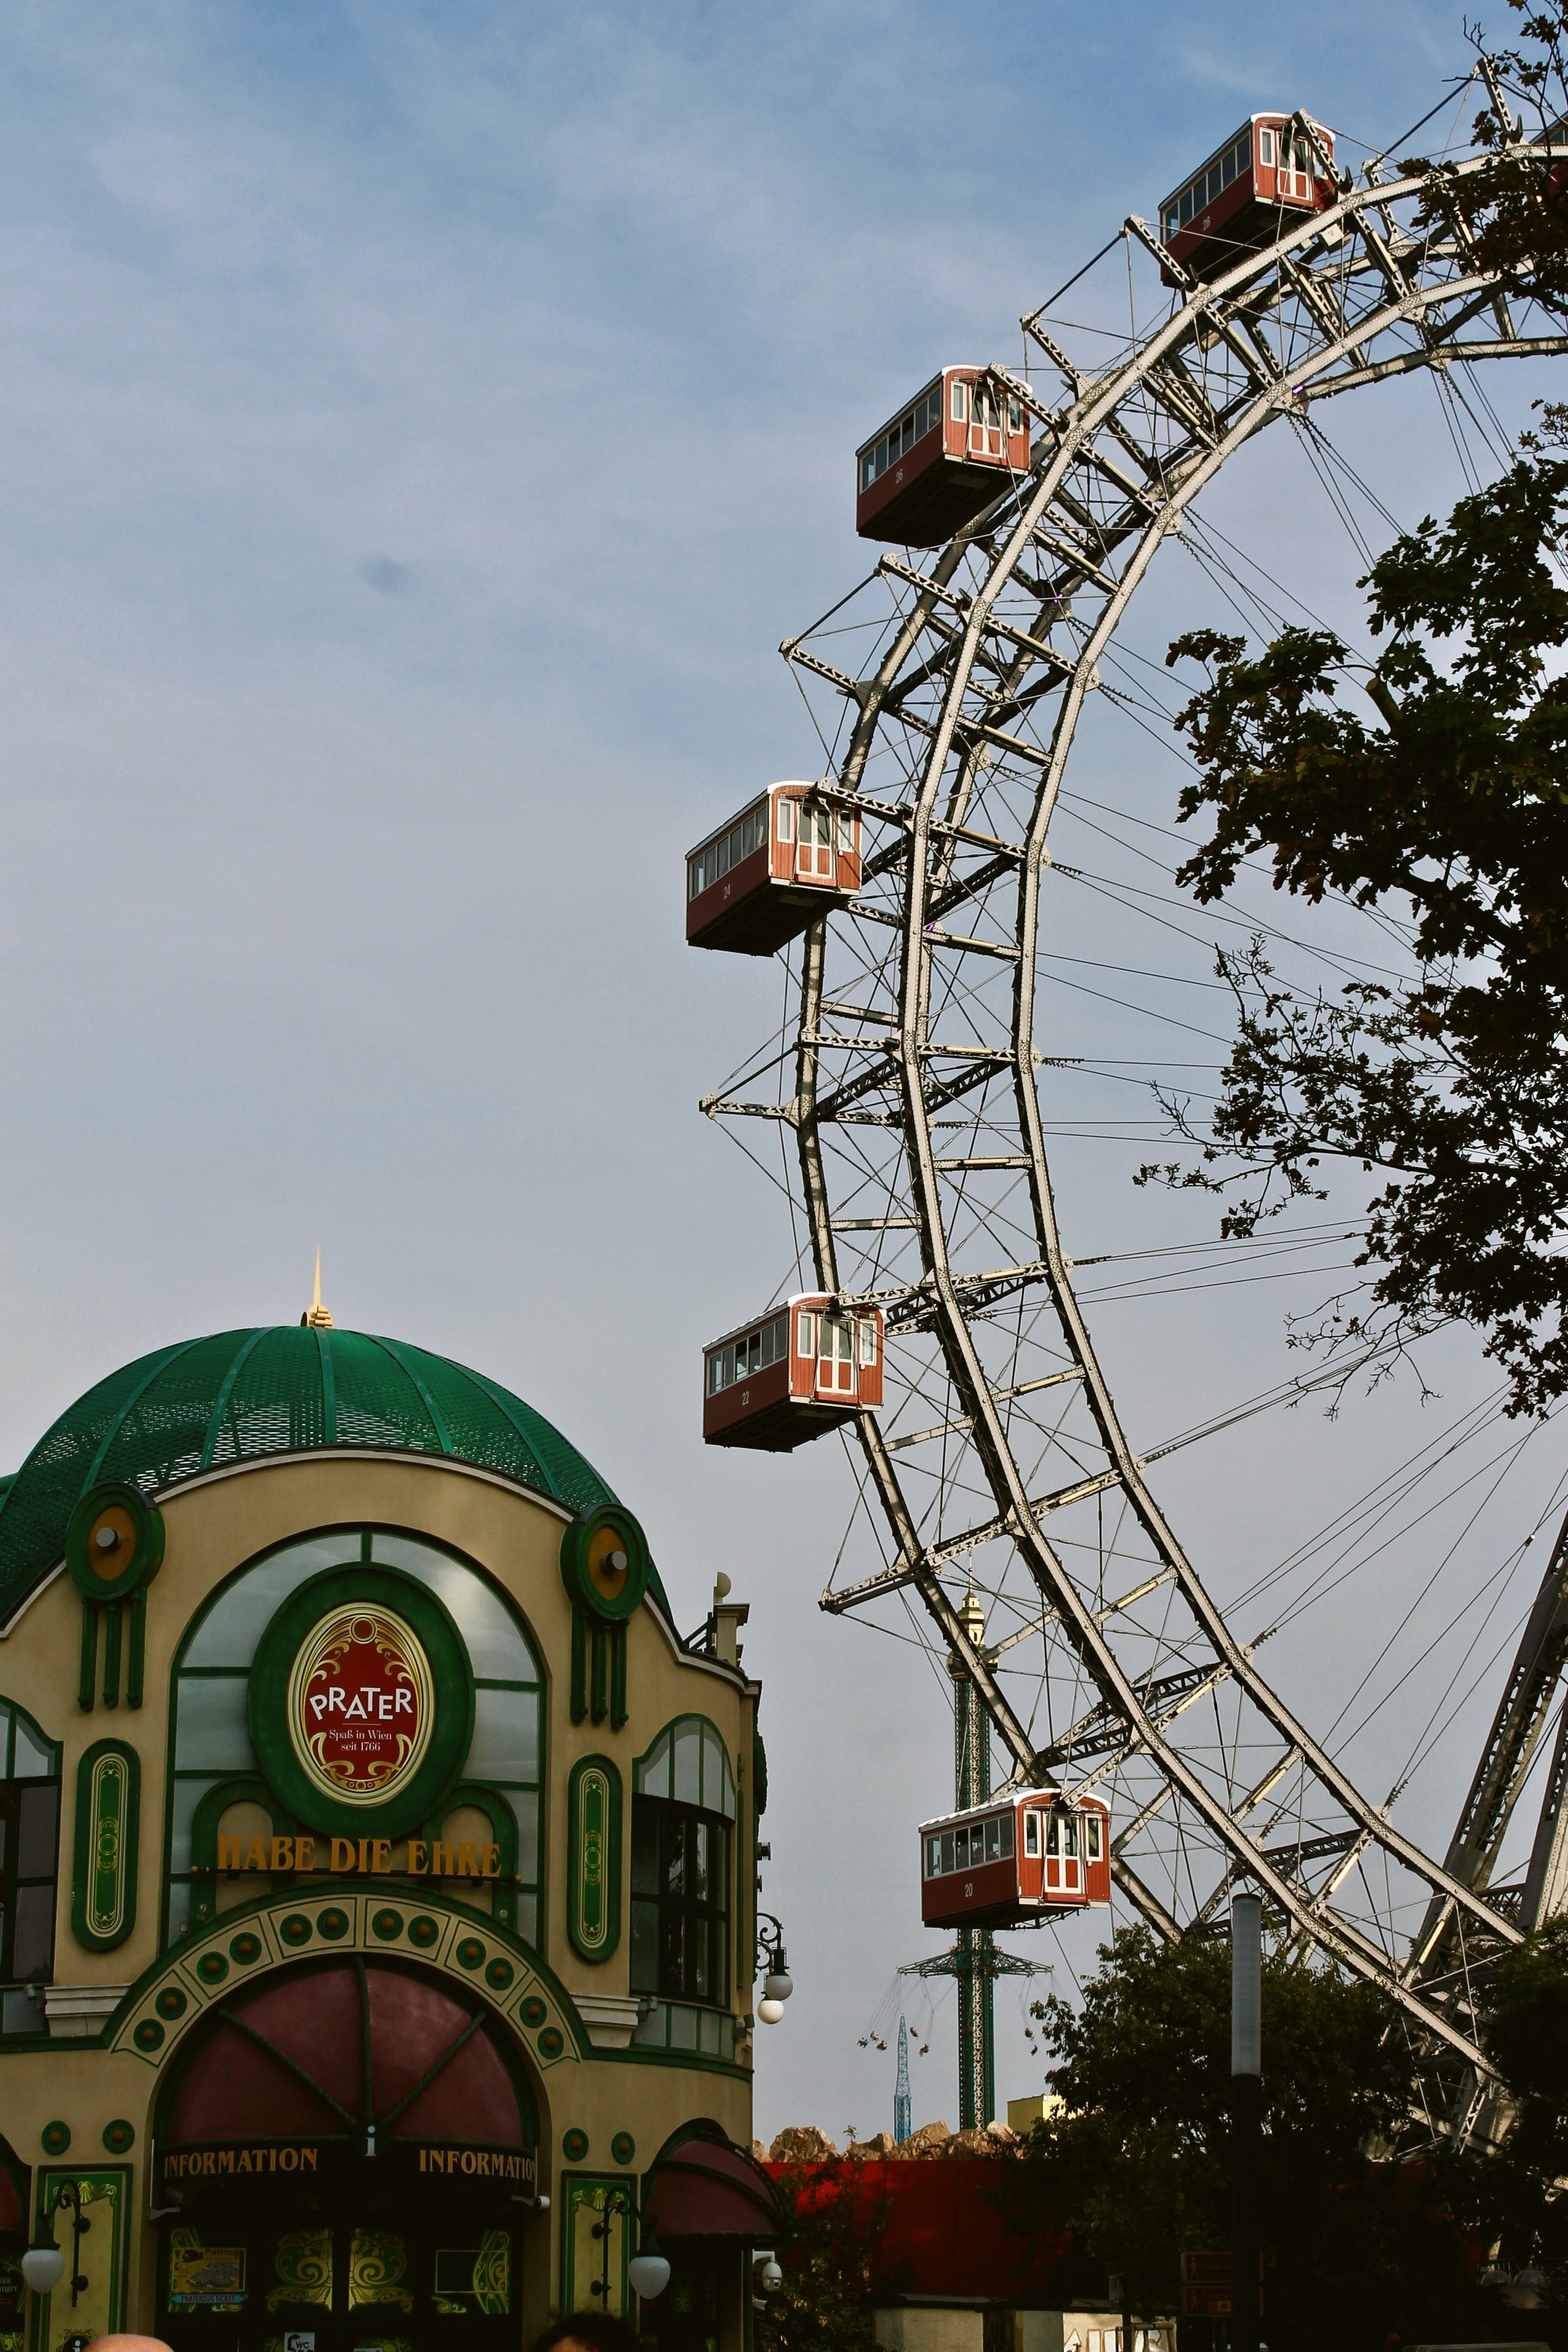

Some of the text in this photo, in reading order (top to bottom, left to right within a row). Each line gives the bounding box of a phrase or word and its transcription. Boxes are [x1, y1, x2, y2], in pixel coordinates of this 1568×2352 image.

[1202, 216, 1210, 231] 28
[896, 468, 903, 484] 26
[723, 884, 731, 899] 24
[742, 1391, 750, 1406] 22
[309, 1687, 413, 1720] PRATER
[329, 1729, 392, 1741] Spaß in Wien
[341, 1742, 381, 1752] seit 1766
[217, 1836, 502, 1878] HABE DIE EHRE
[965, 1883, 973, 1898] 20
[365, 2125, 377, 2156] i
[164, 2148, 318, 2178] INFORMATION
[205, 2248, 239, 2257] Praterzug
